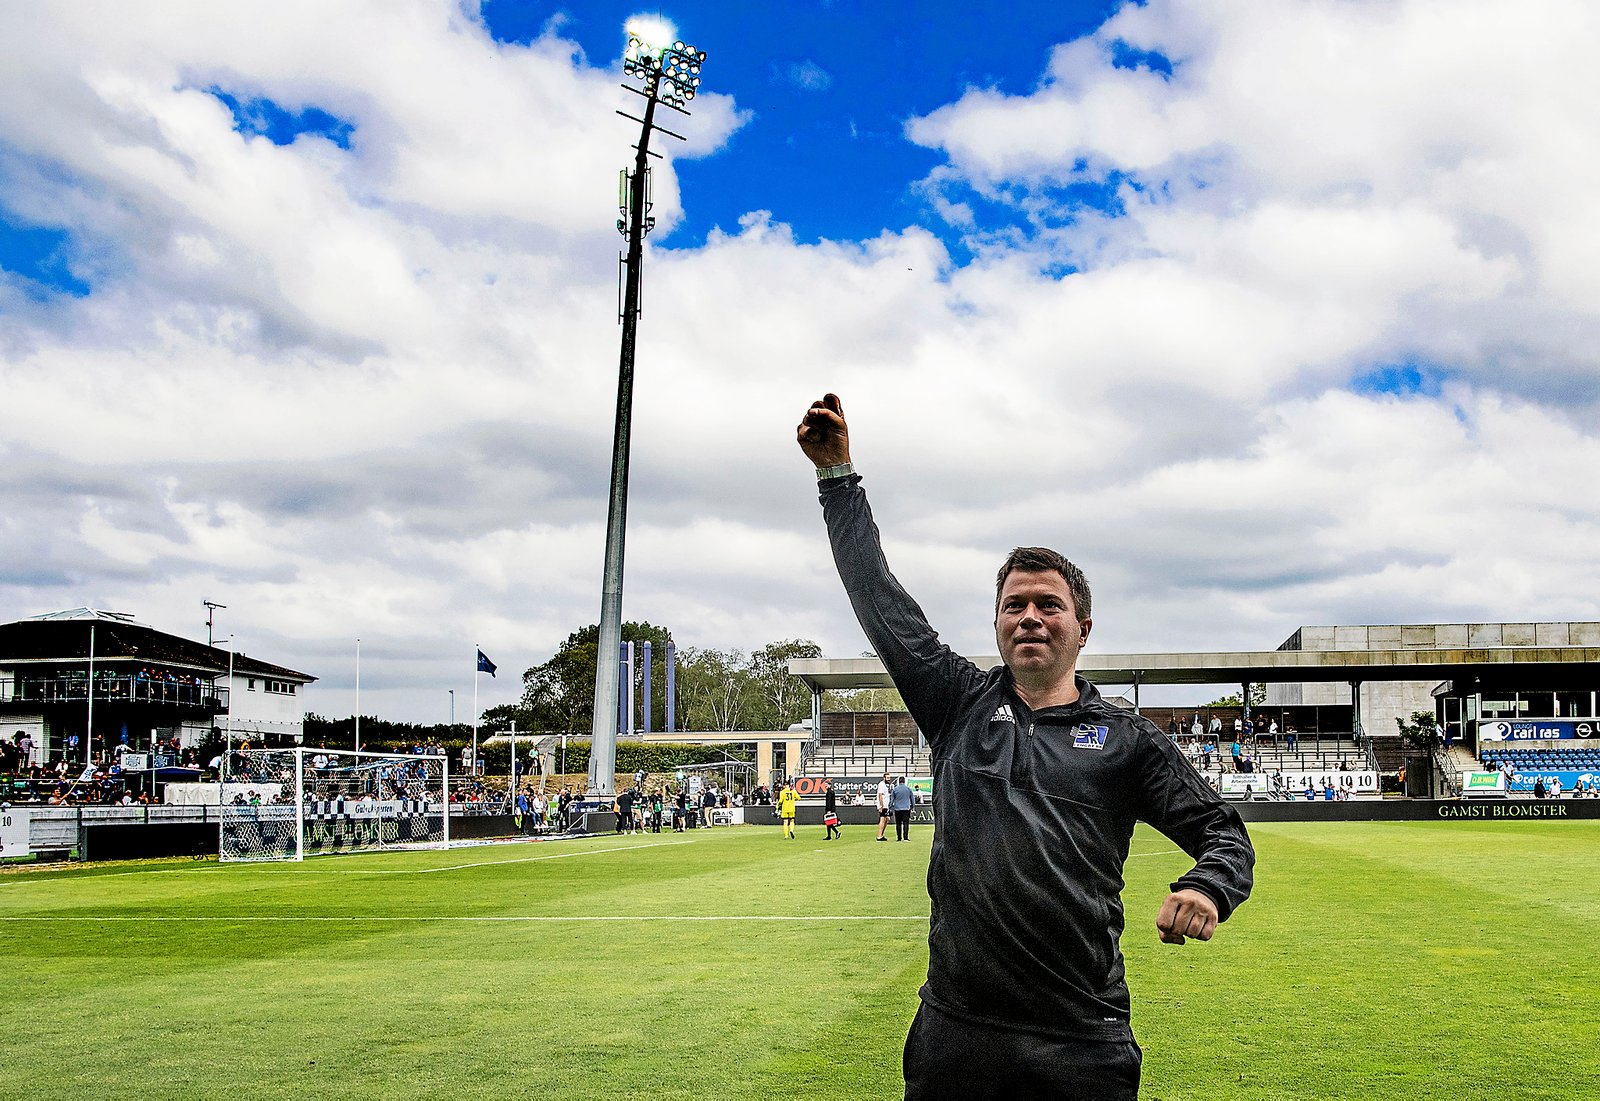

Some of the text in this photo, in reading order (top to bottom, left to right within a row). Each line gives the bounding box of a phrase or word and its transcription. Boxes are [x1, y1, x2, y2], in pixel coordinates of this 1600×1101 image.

[1513, 726, 1560, 739] carl ras
[795, 778, 895, 794] OK Støtter Spoen
[1300, 775, 1312, 787] 41
[1319, 775, 1332, 787] 41
[1340, 775, 1353, 787] 10
[1358, 775, 1372, 787] 10
[785, 792, 793, 801] 31
[909, 811, 935, 821] GAM
[1438, 805, 1567, 817] GAMST BLOMSTER
[2, 816, 12, 827] 10
[295, 824, 338, 843] AMST
